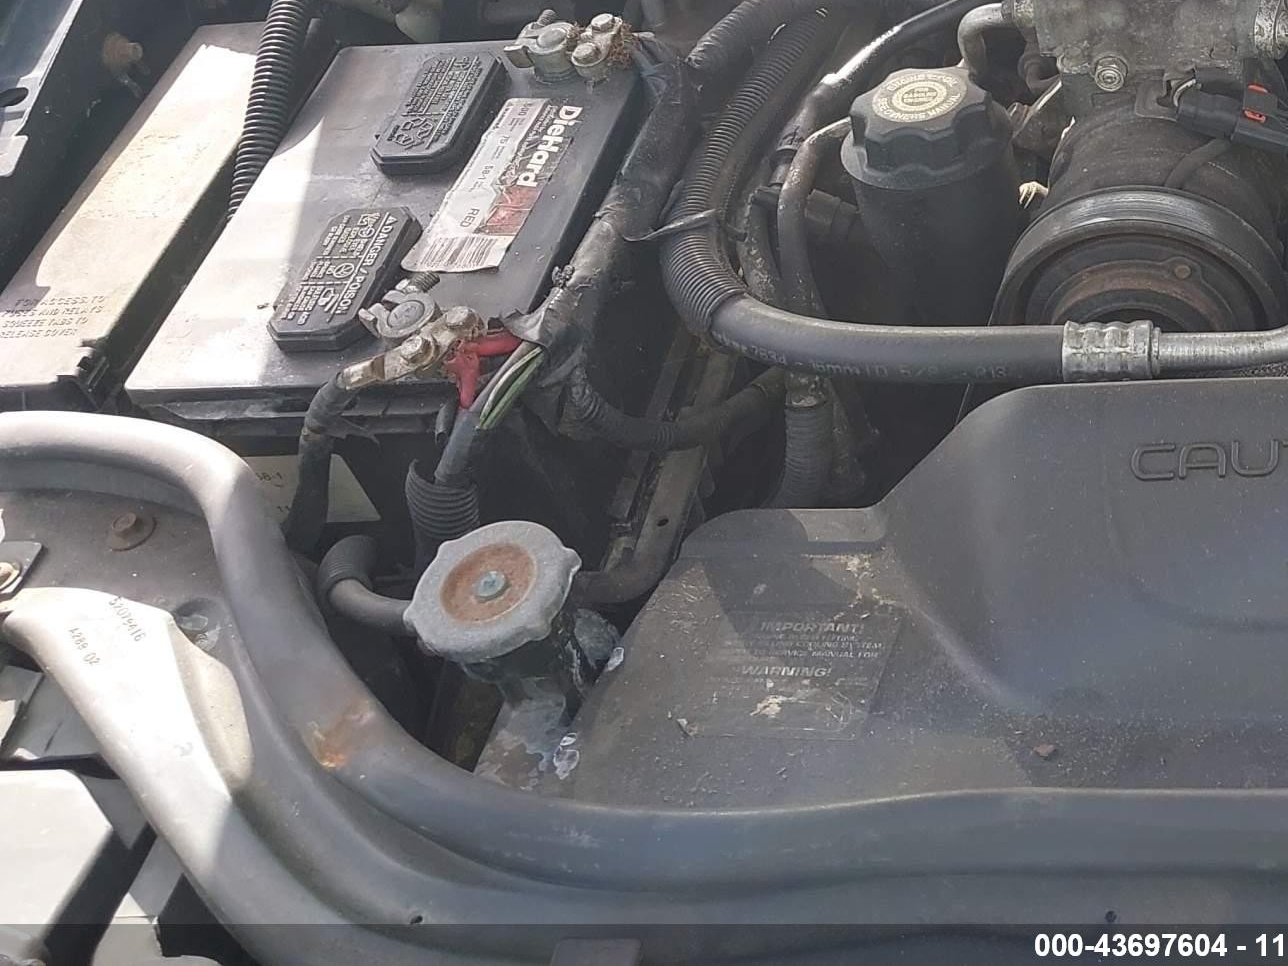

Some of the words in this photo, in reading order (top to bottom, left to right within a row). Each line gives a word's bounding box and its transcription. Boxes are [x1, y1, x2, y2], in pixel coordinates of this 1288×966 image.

[516, 105, 583, 187] DieHard
[459, 207, 480, 228] RED
[362, 225, 394, 267] DANGER
[335, 275, 366, 315] POISON
[741, 666, 832, 677] WARNING!
